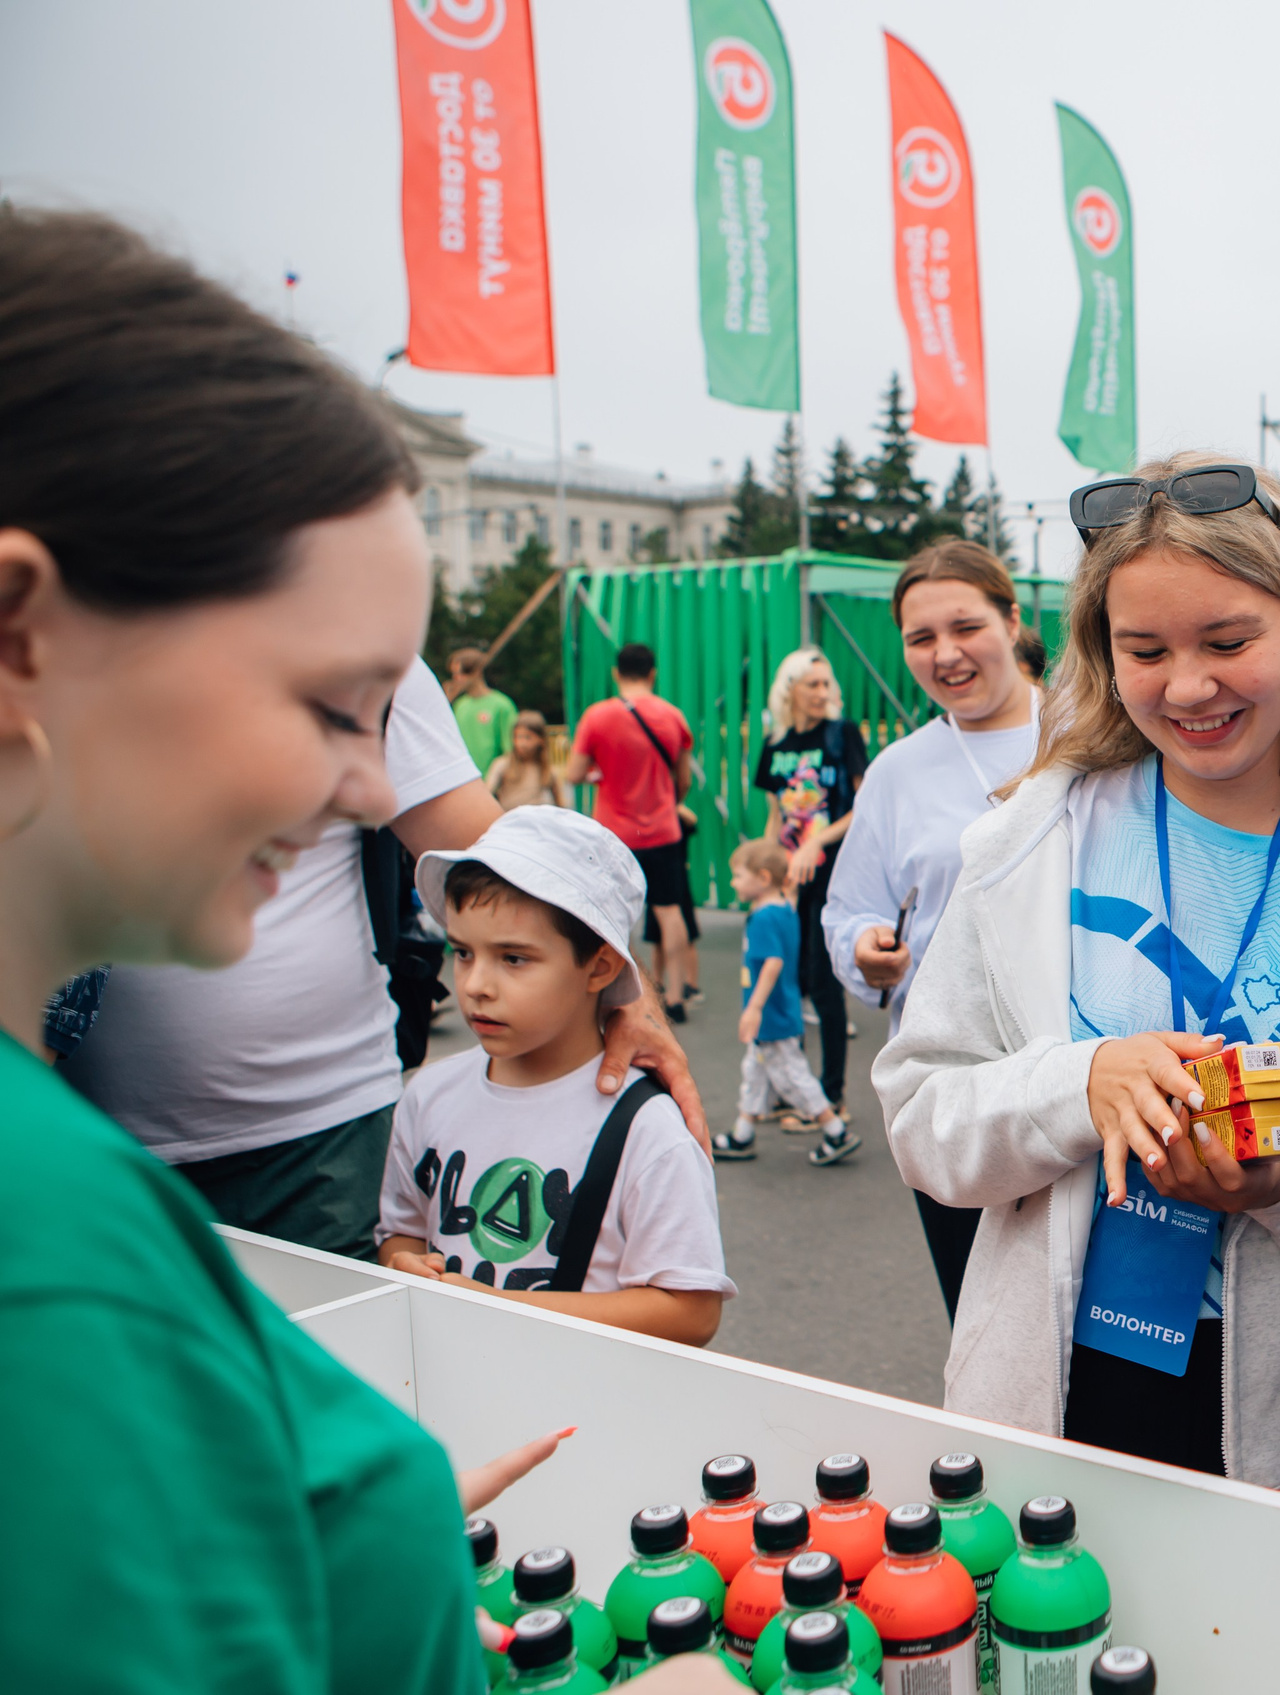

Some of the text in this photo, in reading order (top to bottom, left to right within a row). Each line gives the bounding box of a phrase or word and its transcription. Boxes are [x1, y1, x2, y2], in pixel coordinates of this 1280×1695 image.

[1173, 1208, 1210, 1224] СИБИРСКИЙ
[1171, 1218, 1208, 1235] МАРАФОН
[1090, 1305, 1186, 1345] ВОЛОНТЕР
